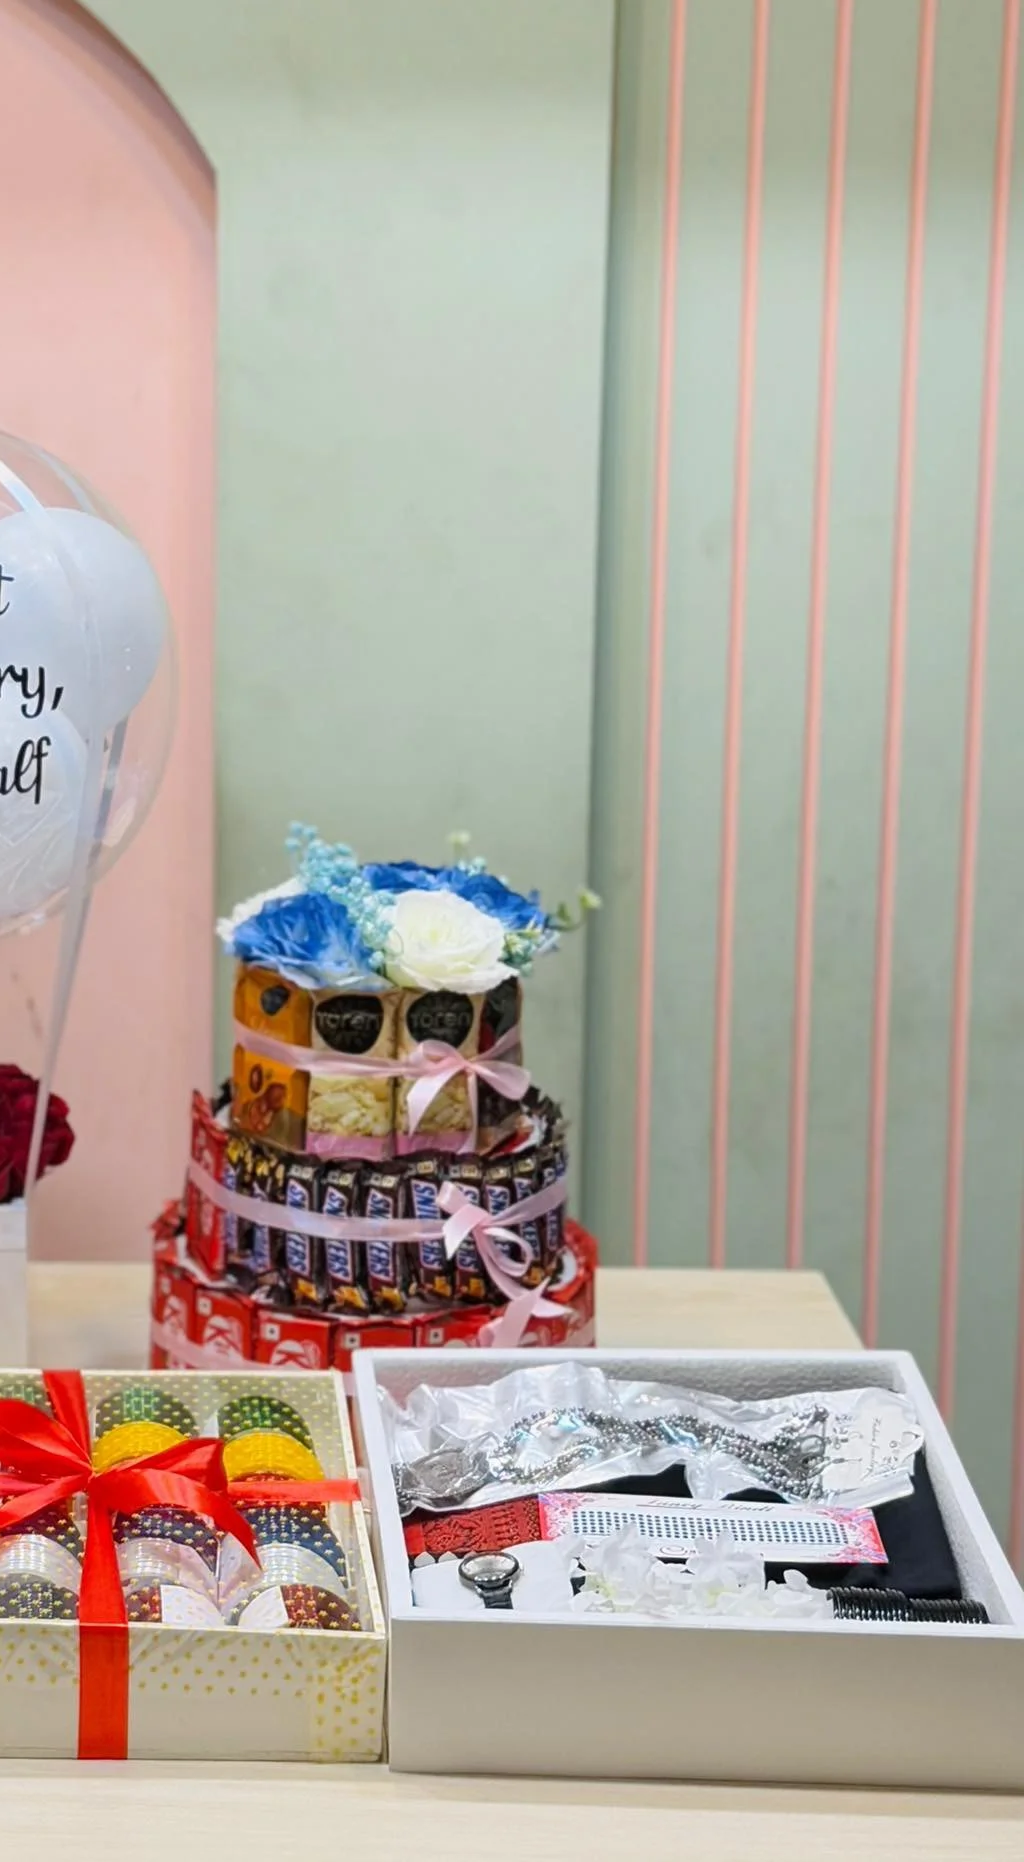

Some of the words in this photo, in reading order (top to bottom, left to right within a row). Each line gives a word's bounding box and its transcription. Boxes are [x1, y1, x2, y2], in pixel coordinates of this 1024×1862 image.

[288, 1184, 308, 1273] SNERS
[327, 1191, 349, 1278] SNERS
[370, 1193, 392, 1278] SNERS
